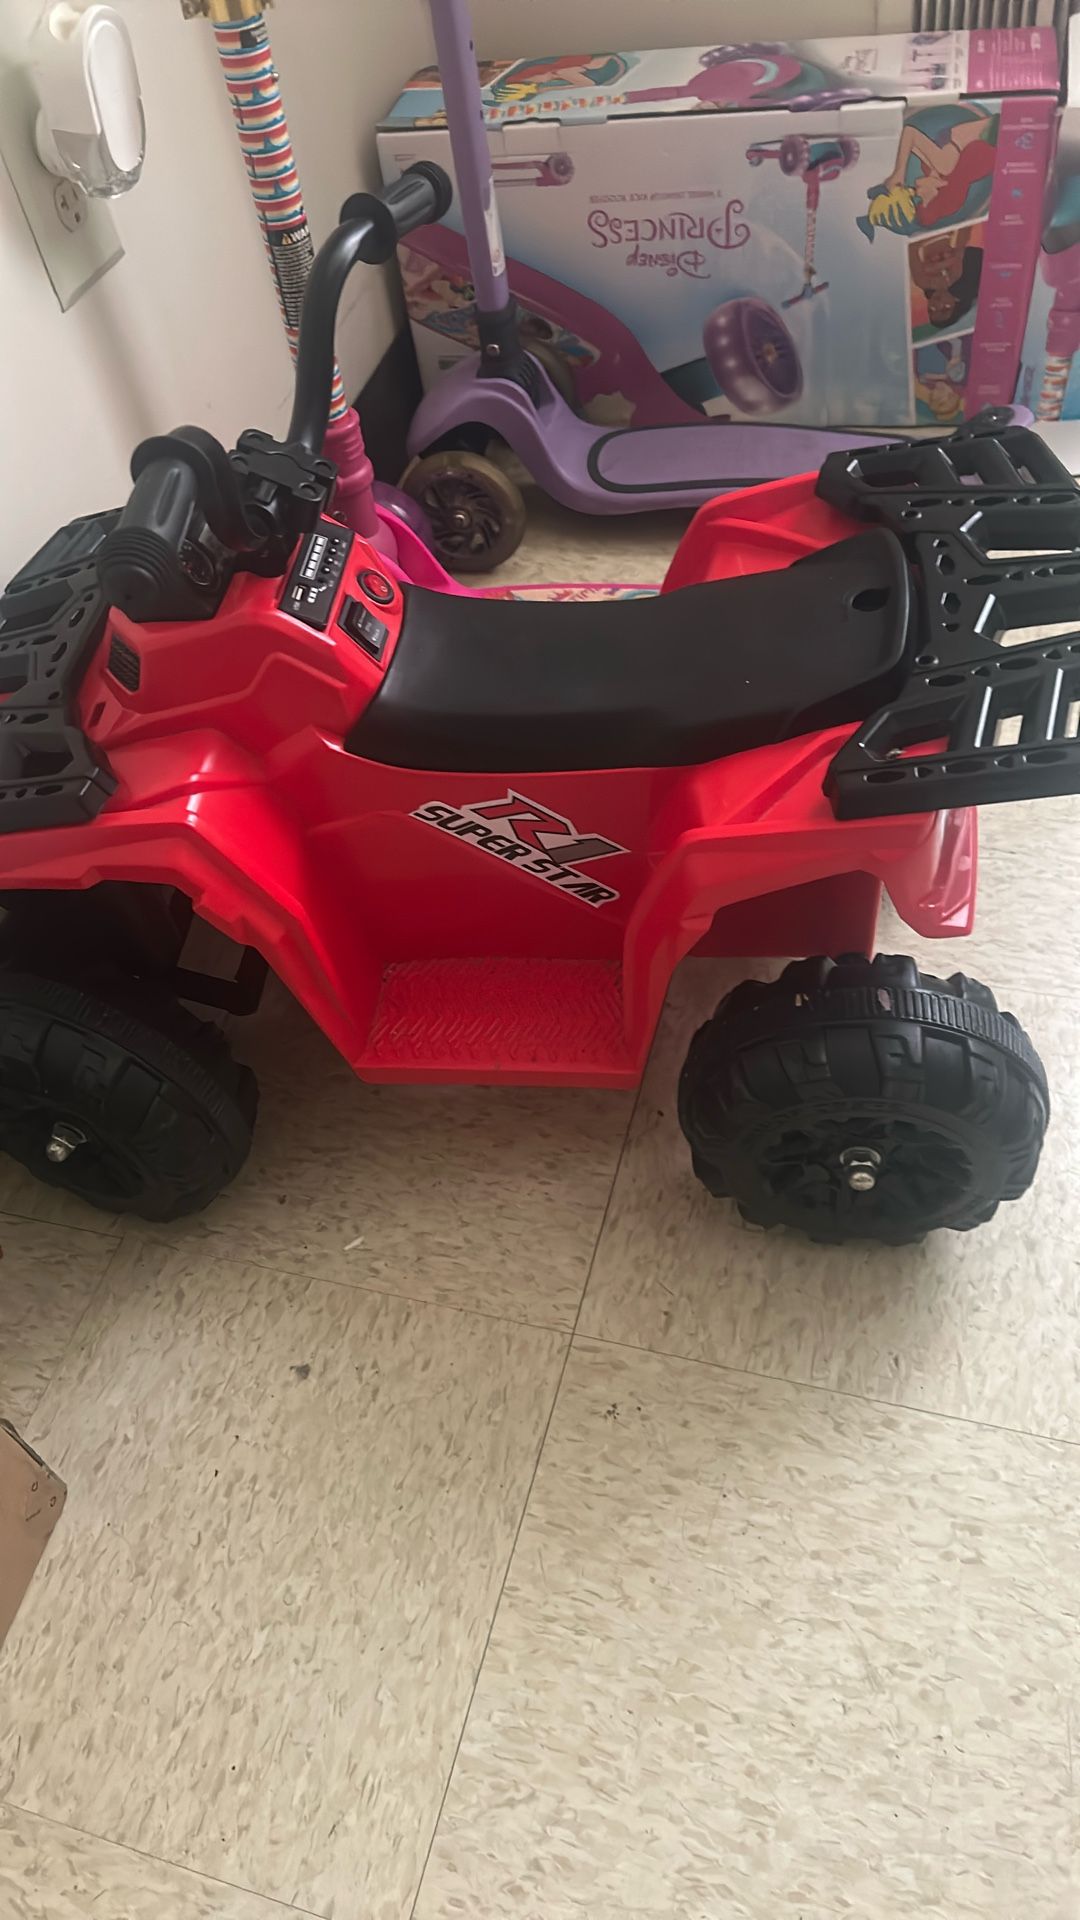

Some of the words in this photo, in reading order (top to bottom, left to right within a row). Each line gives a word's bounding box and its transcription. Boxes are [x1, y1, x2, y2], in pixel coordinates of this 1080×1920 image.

[587, 199, 751, 249] PRINCESS
[413, 805, 532, 861] SUPER
[521, 857, 617, 904] STAR
